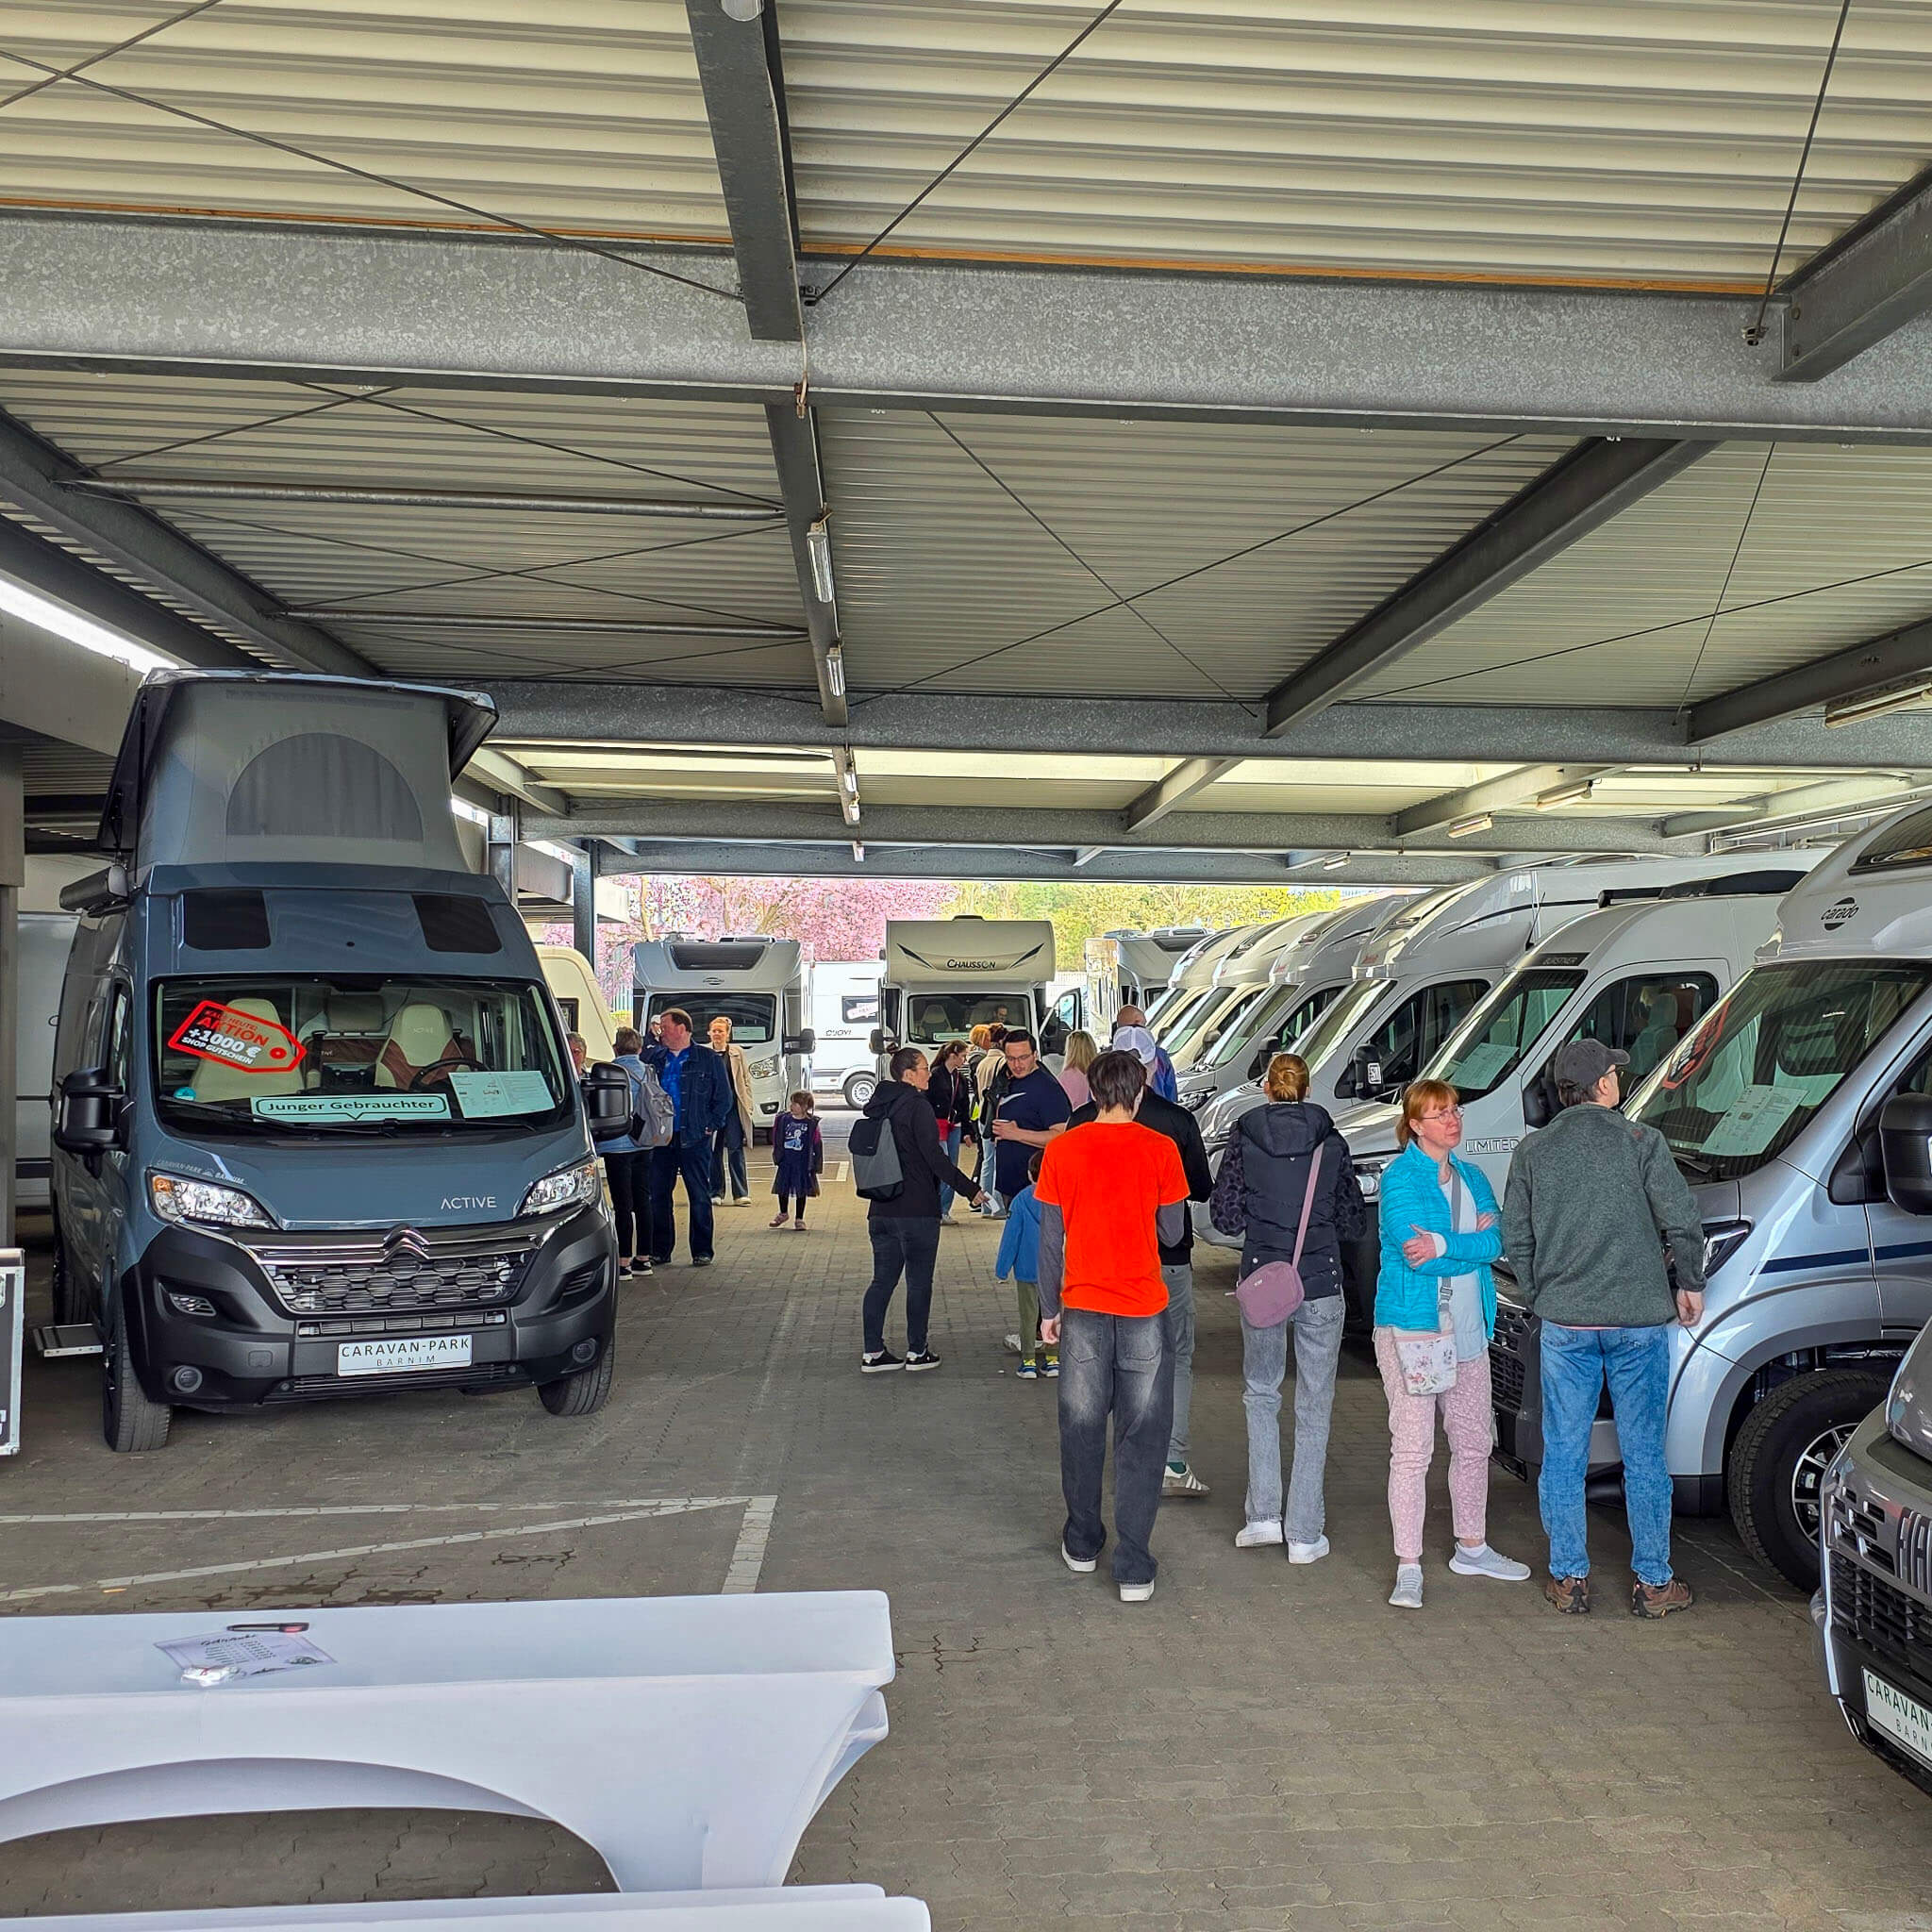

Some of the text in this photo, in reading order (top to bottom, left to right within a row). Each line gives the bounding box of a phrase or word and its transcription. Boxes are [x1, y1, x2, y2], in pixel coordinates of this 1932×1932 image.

[196, 1017, 270, 1047] AKTION
[181, 1036, 255, 1065] SHOP GUTSCHEIN
[189, 1028, 261, 1058] +1000 €
[268, 1099, 435, 1112] Junger Gebrauchter
[1466, 1138, 1521, 1153] LIMITED
[441, 1196, 498, 1209] ACTIVE
[341, 1338, 469, 1357] CARAVAN-PARK
[376, 1355, 435, 1367] BARNIM
[1896, 1507, 1932, 1596] FIA
